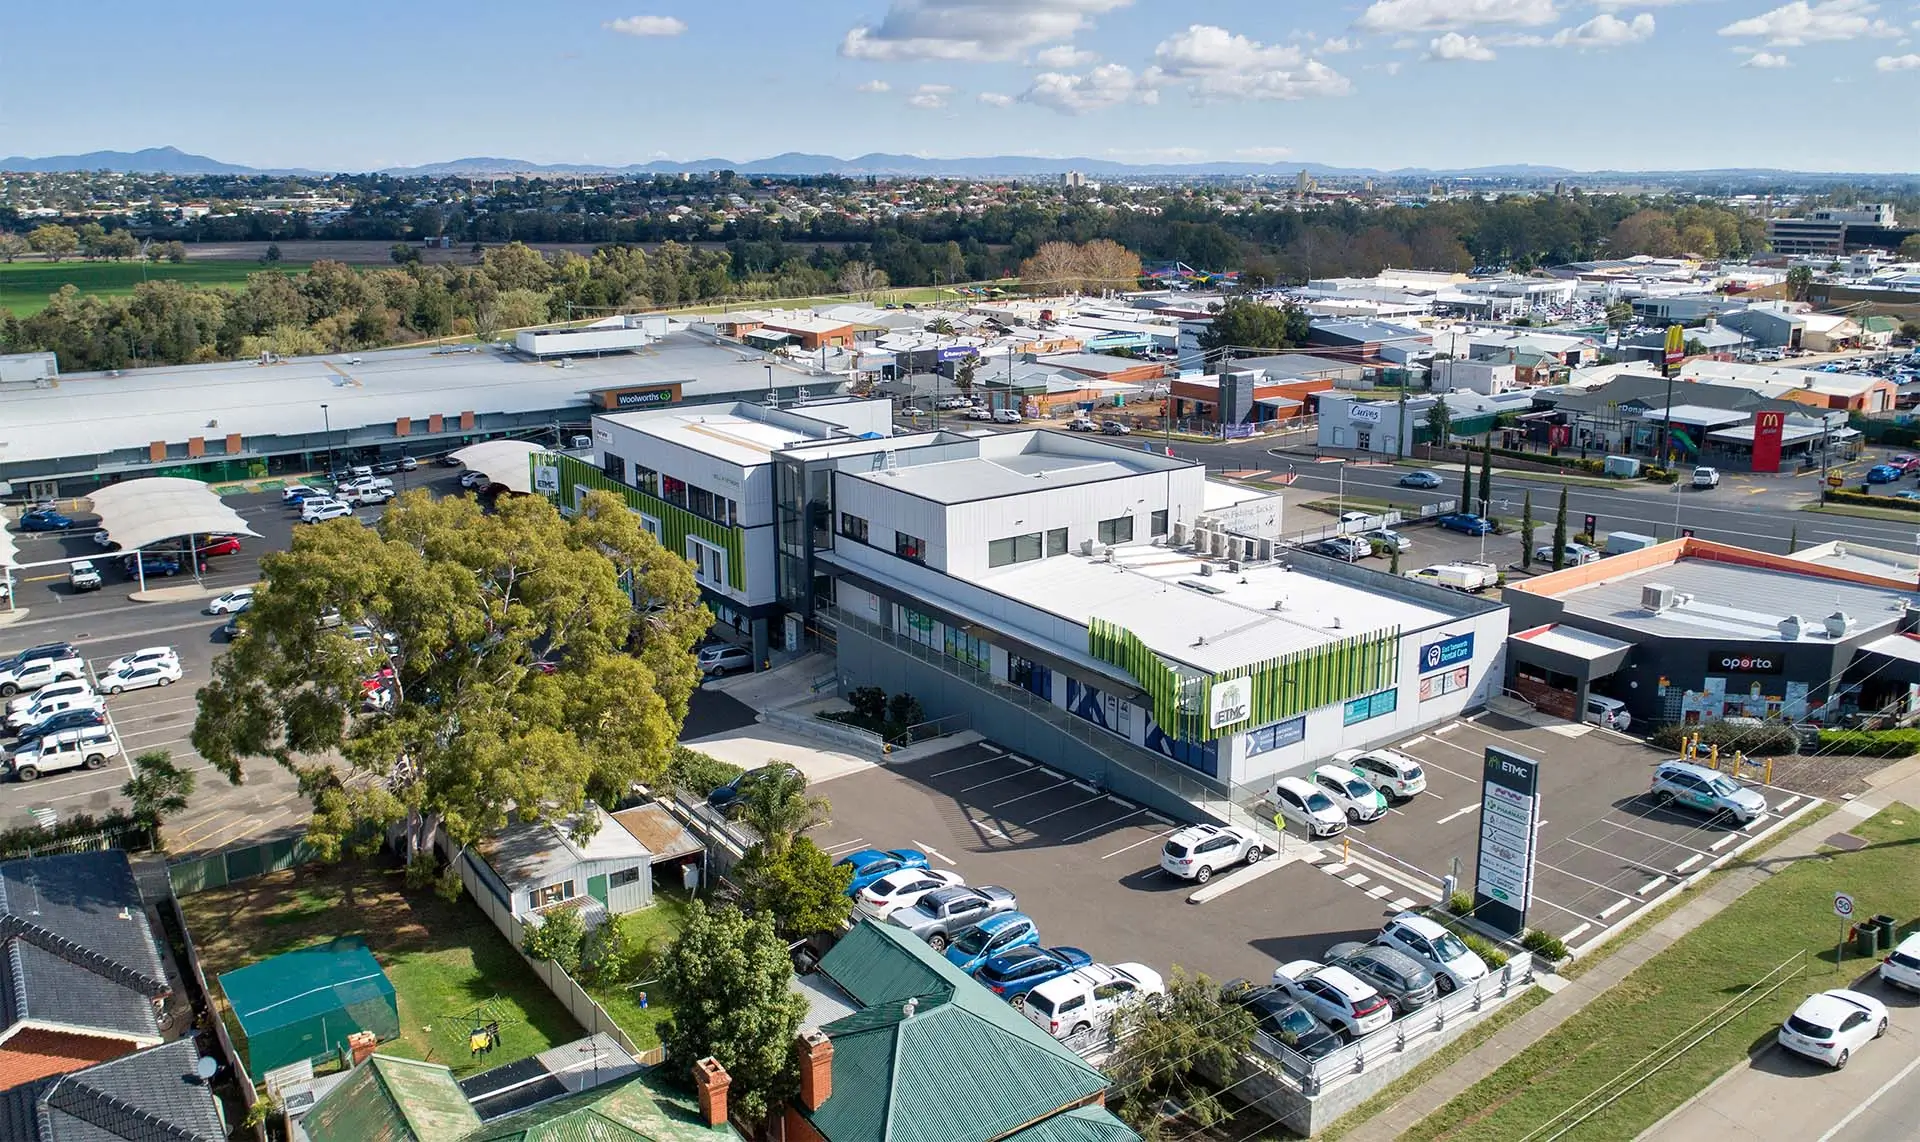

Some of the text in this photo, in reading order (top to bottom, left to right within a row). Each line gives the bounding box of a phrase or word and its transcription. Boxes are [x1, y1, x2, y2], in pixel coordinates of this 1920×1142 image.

[619, 393, 660, 404] Woolworths
[1351, 405, 1378, 420] Curves
[537, 479, 555, 489] ETMC
[1441, 647, 1468, 662] Dental Care
[1721, 658, 1772, 670] oporto
[1216, 704, 1246, 723] ETMC
[1502, 761, 1528, 778] ETMC
[1838, 899, 1850, 911] 50
